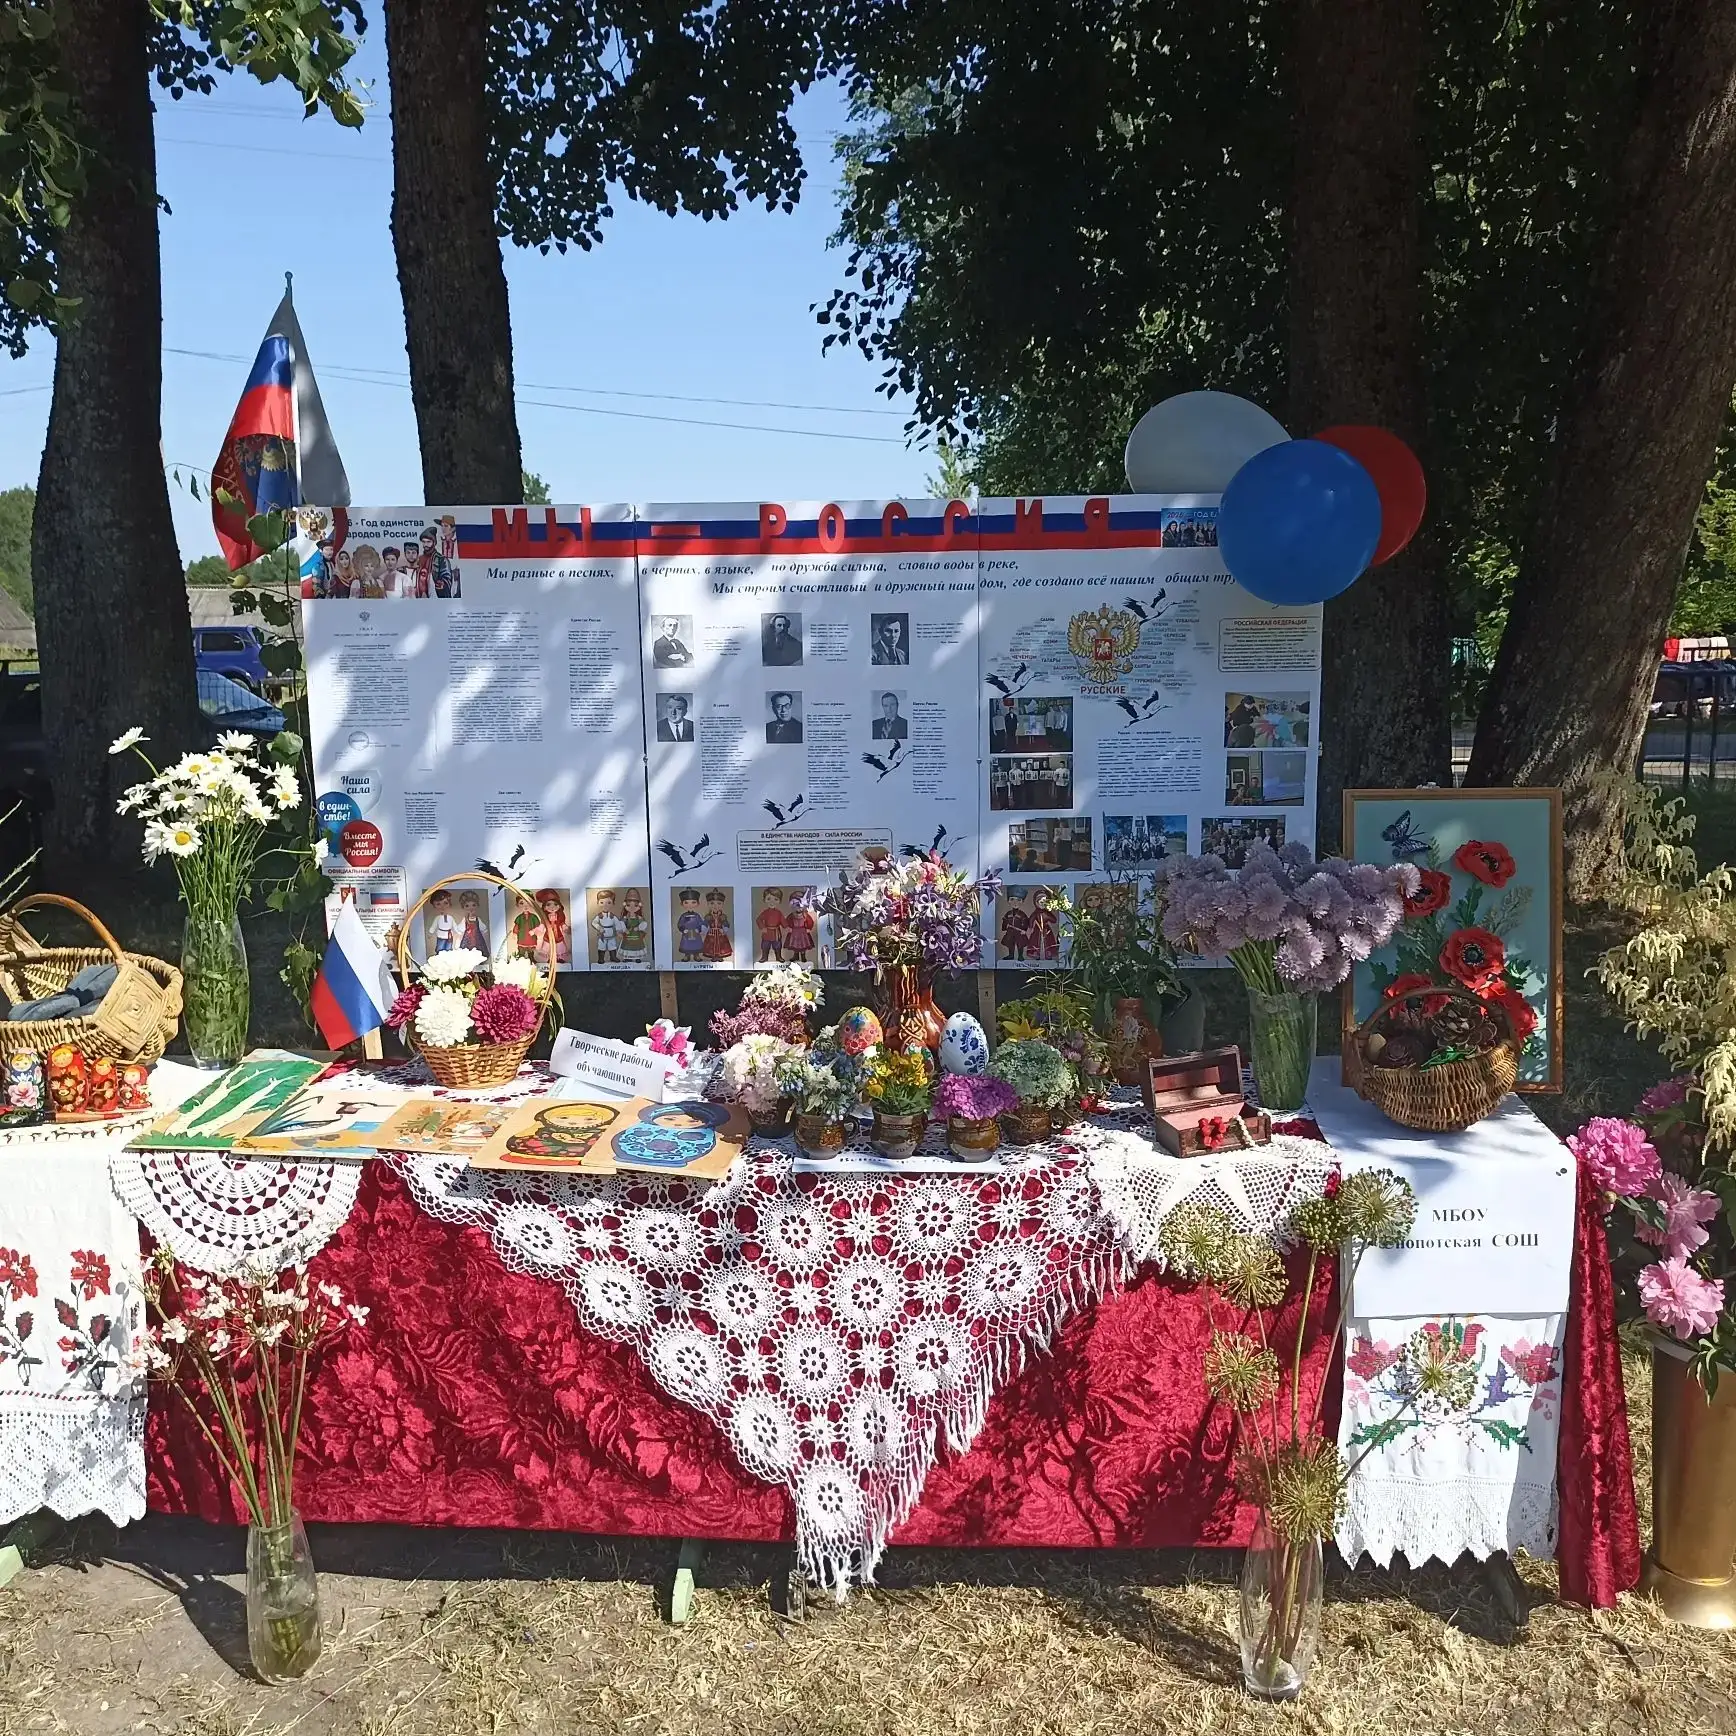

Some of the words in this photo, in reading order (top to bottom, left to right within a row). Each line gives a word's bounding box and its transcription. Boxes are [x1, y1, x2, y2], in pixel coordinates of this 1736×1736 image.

[361, 519, 378, 527] Год
[380, 519, 424, 527] единства
[491, 507, 593, 553] МЫ
[759, 497, 1110, 553] РОССИЯ
[347, 531, 380, 539] ародов
[383, 530, 417, 538] России
[486, 567, 508, 579] Мы
[511, 569, 555, 581] разные
[558, 569, 565, 578] в
[568, 569, 614, 579] песнях,
[641, 567, 648, 576] в
[651, 566, 701, 578] чертах,
[704, 567, 711, 575] в
[714, 566, 754, 576] языке,
[771, 563, 787, 572] но
[789, 561, 837, 575] дружба
[841, 562, 887, 573] сильна,
[898, 561, 941, 571] словно
[943, 560, 974, 570] воды
[978, 560, 985, 569] в
[987, 560, 1019, 572] реке,
[712, 583, 734, 594] Мы
[737, 584, 786, 596] строим
[789, 581, 867, 593] счастливый
[874, 583, 882, 592] и
[885, 581, 945, 595] дружный
[948, 581, 975, 591] наш
[979, 578, 1007, 590] дом,
[1012, 577, 1032, 588] где
[1035, 577, 1084, 587] создано
[1087, 575, 1107, 586] всё
[1110, 575, 1155, 585] нашим
[1165, 571, 1210, 584] общим
[1080, 686, 1126, 694] РУССКИЕ
[340, 775, 370, 785] Наша
[346, 786, 371, 794] сила
[326, 803, 352, 813] един-
[323, 811, 351, 821] стве!
[343, 831, 377, 840] Вместе
[344, 847, 379, 857] Россия!
[569, 1035, 620, 1060] Творческие
[620, 1052, 654, 1069] работы
[576, 1060, 637, 1087] обучающихся
[1432, 1208, 1488, 1222] МБОУ
[1379, 1238, 1481, 1249] нопотская
[1492, 1233, 1539, 1247] СОШ
